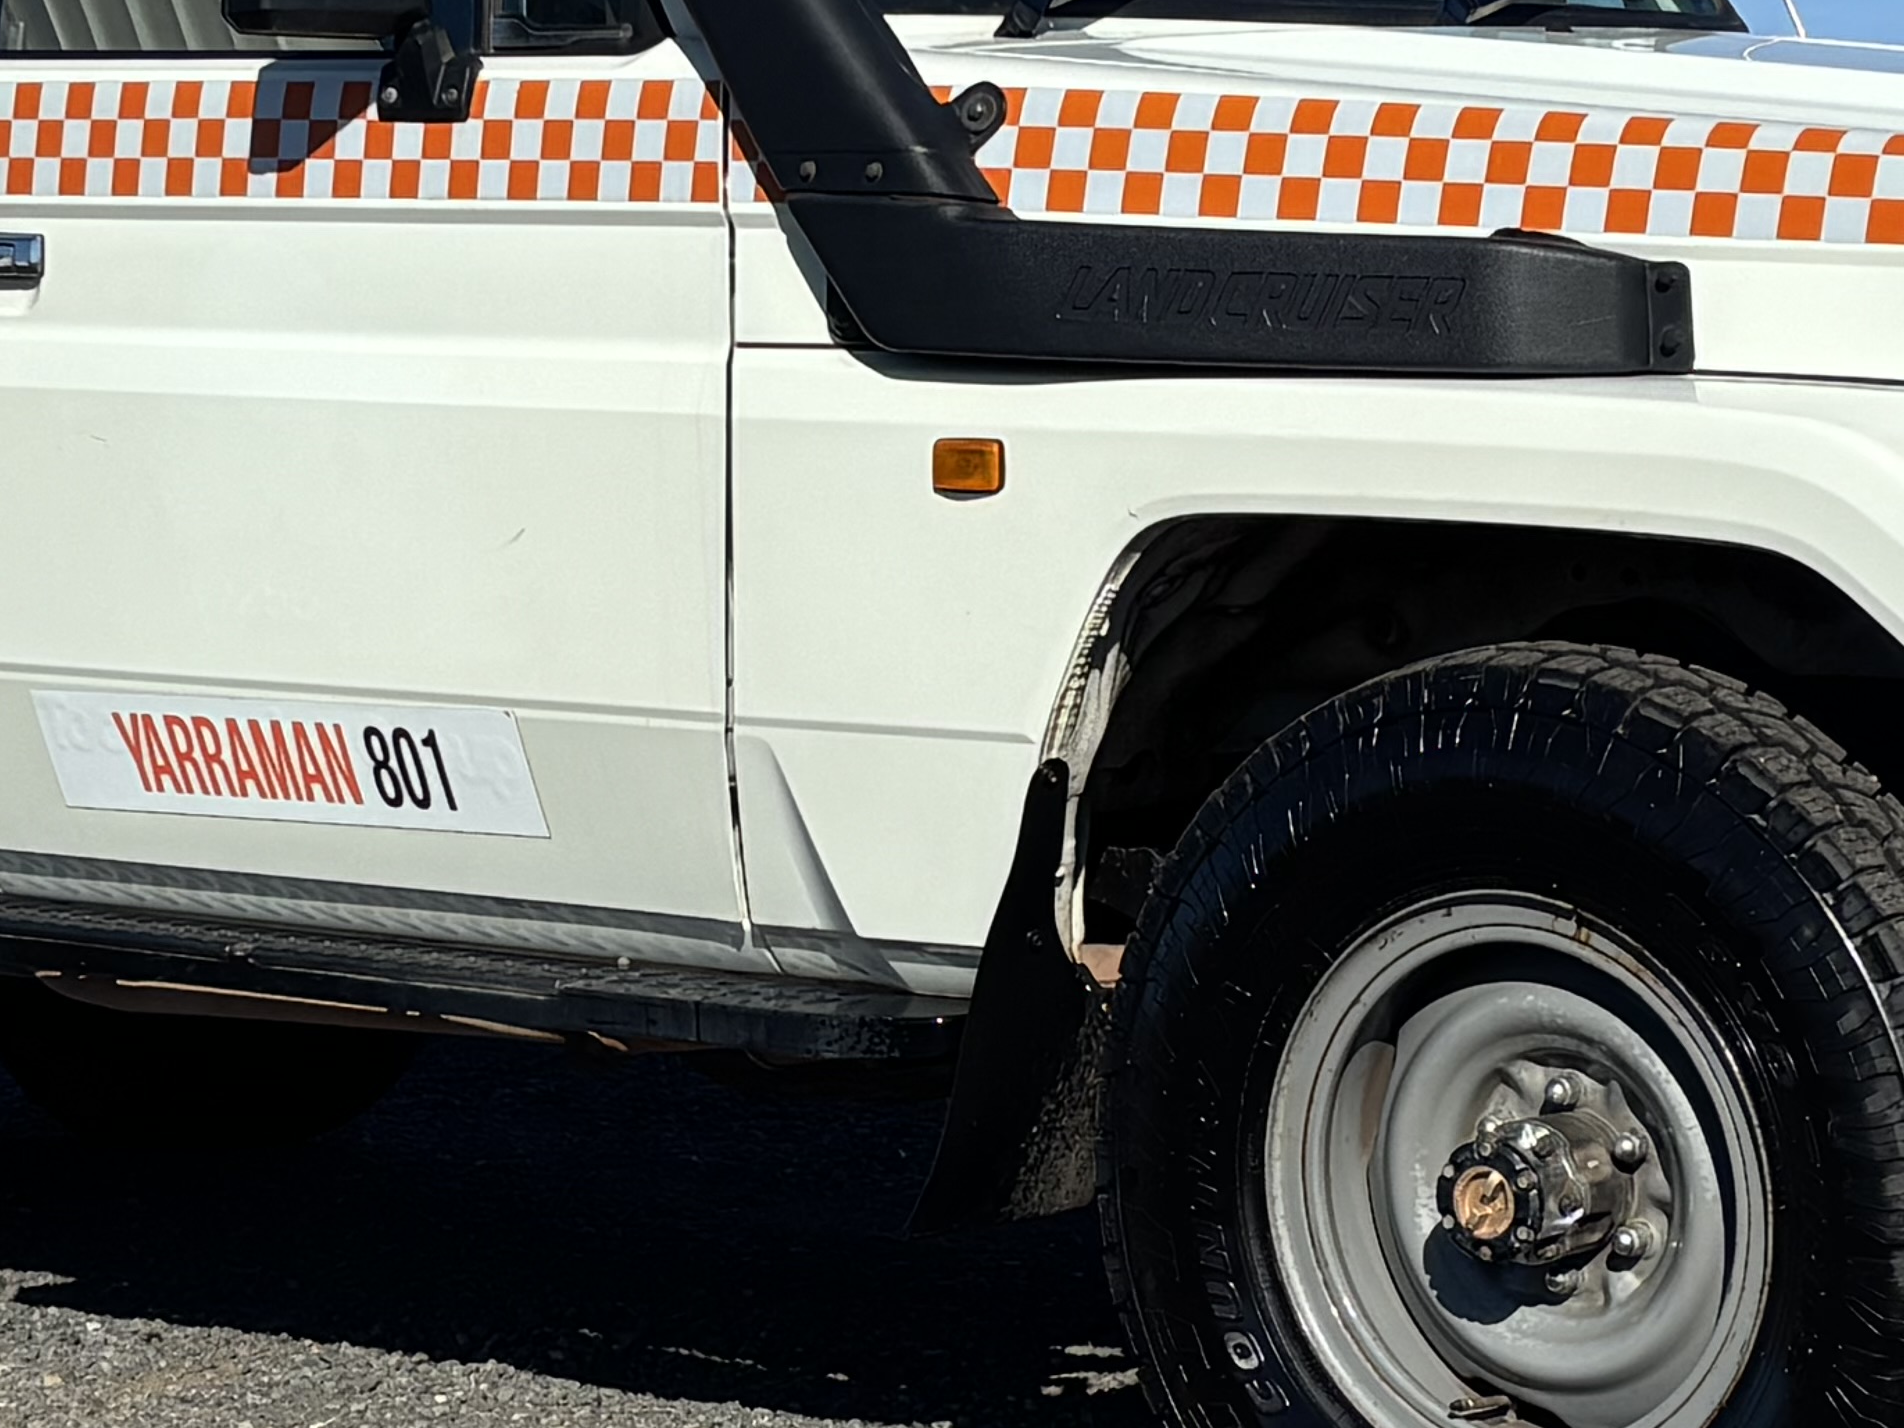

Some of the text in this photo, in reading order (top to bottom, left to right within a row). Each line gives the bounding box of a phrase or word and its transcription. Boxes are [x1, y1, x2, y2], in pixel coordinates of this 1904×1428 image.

[1055, 264, 1468, 335] LANDCRUISER
[111, 711, 458, 812] YARRAMAN 801
